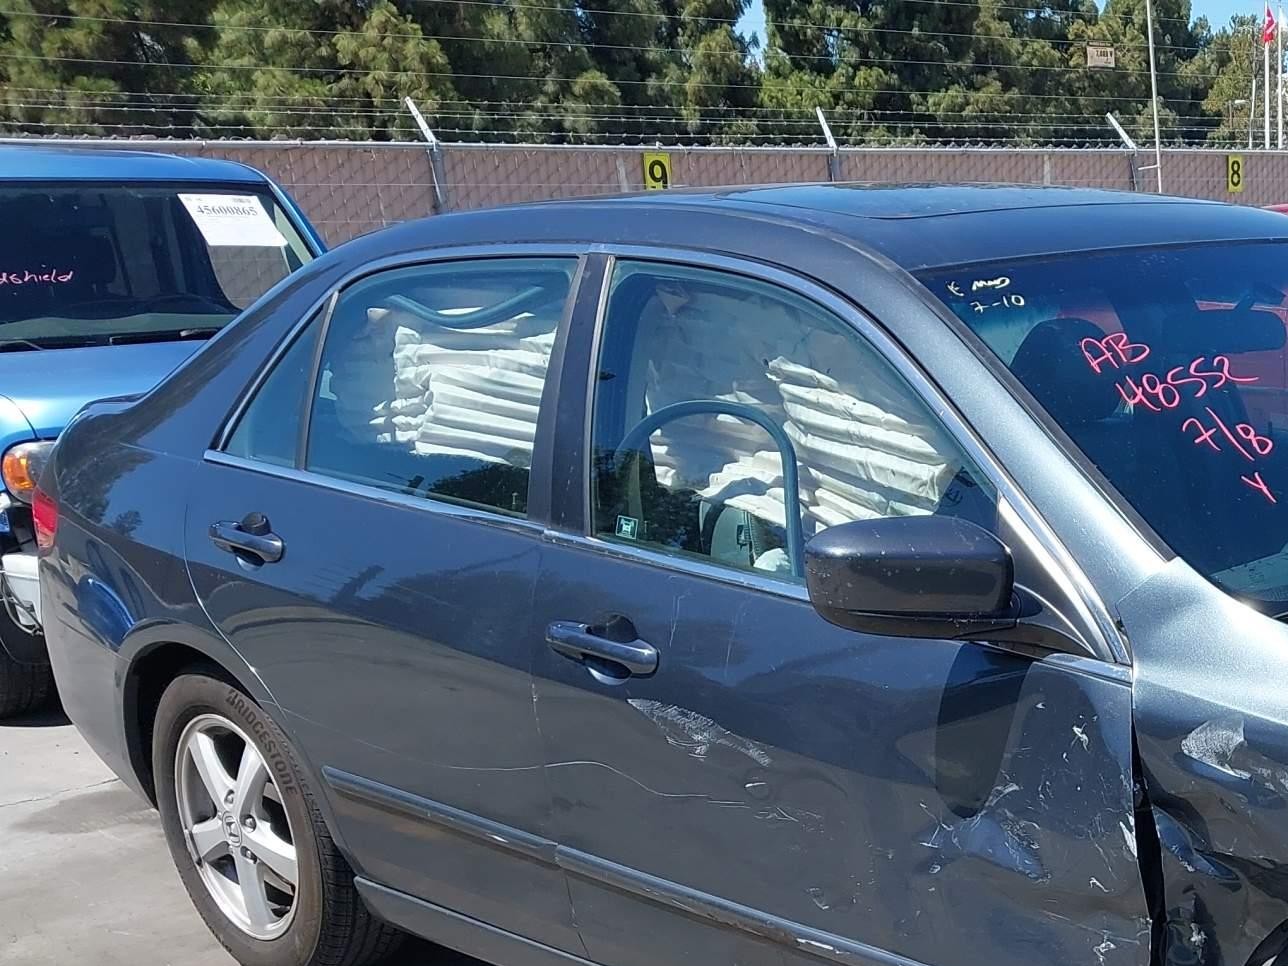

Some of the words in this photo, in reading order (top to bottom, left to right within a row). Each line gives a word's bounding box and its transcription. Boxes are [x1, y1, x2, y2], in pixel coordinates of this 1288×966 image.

[648, 159, 668, 190] 9
[1230, 160, 1241, 187] 8
[197, 205, 258, 217] 45600865
[970, 294, 1026, 313] 7-10
[1080, 332, 1150, 374] AB
[1115, 355, 1260, 412] 48552
[1181, 406, 1274, 462] 7/8
